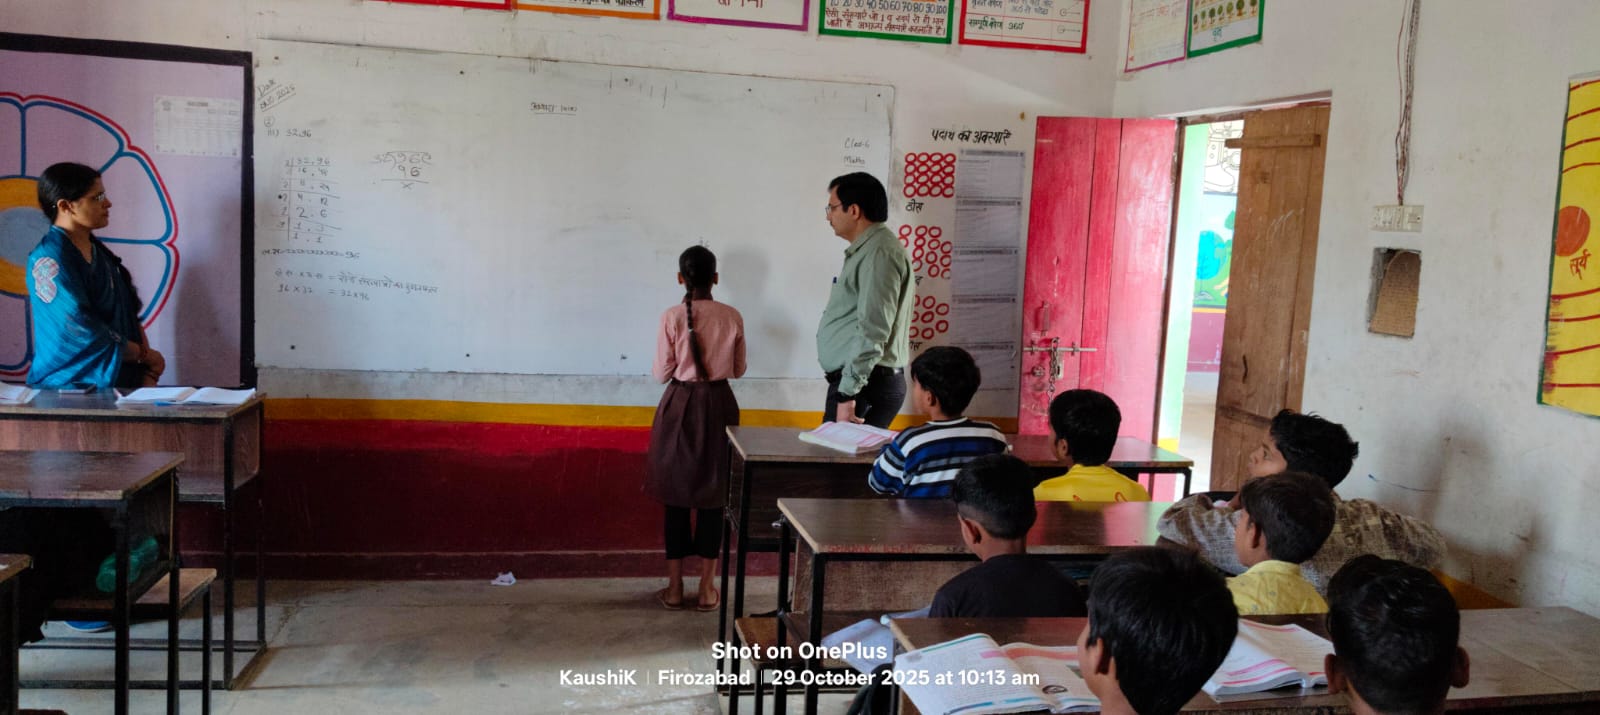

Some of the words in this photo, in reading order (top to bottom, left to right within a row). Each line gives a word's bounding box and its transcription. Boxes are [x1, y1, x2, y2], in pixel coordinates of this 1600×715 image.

[878, 0, 889, 10] 50
[890, 1, 900, 11] 60
[902, 2, 912, 12] 70
[913, 3, 924, 13] 80
[936, 5, 947, 15] 100
[905, 198, 924, 214] ठोस
[1569, 248, 1592, 280] सूर्य
